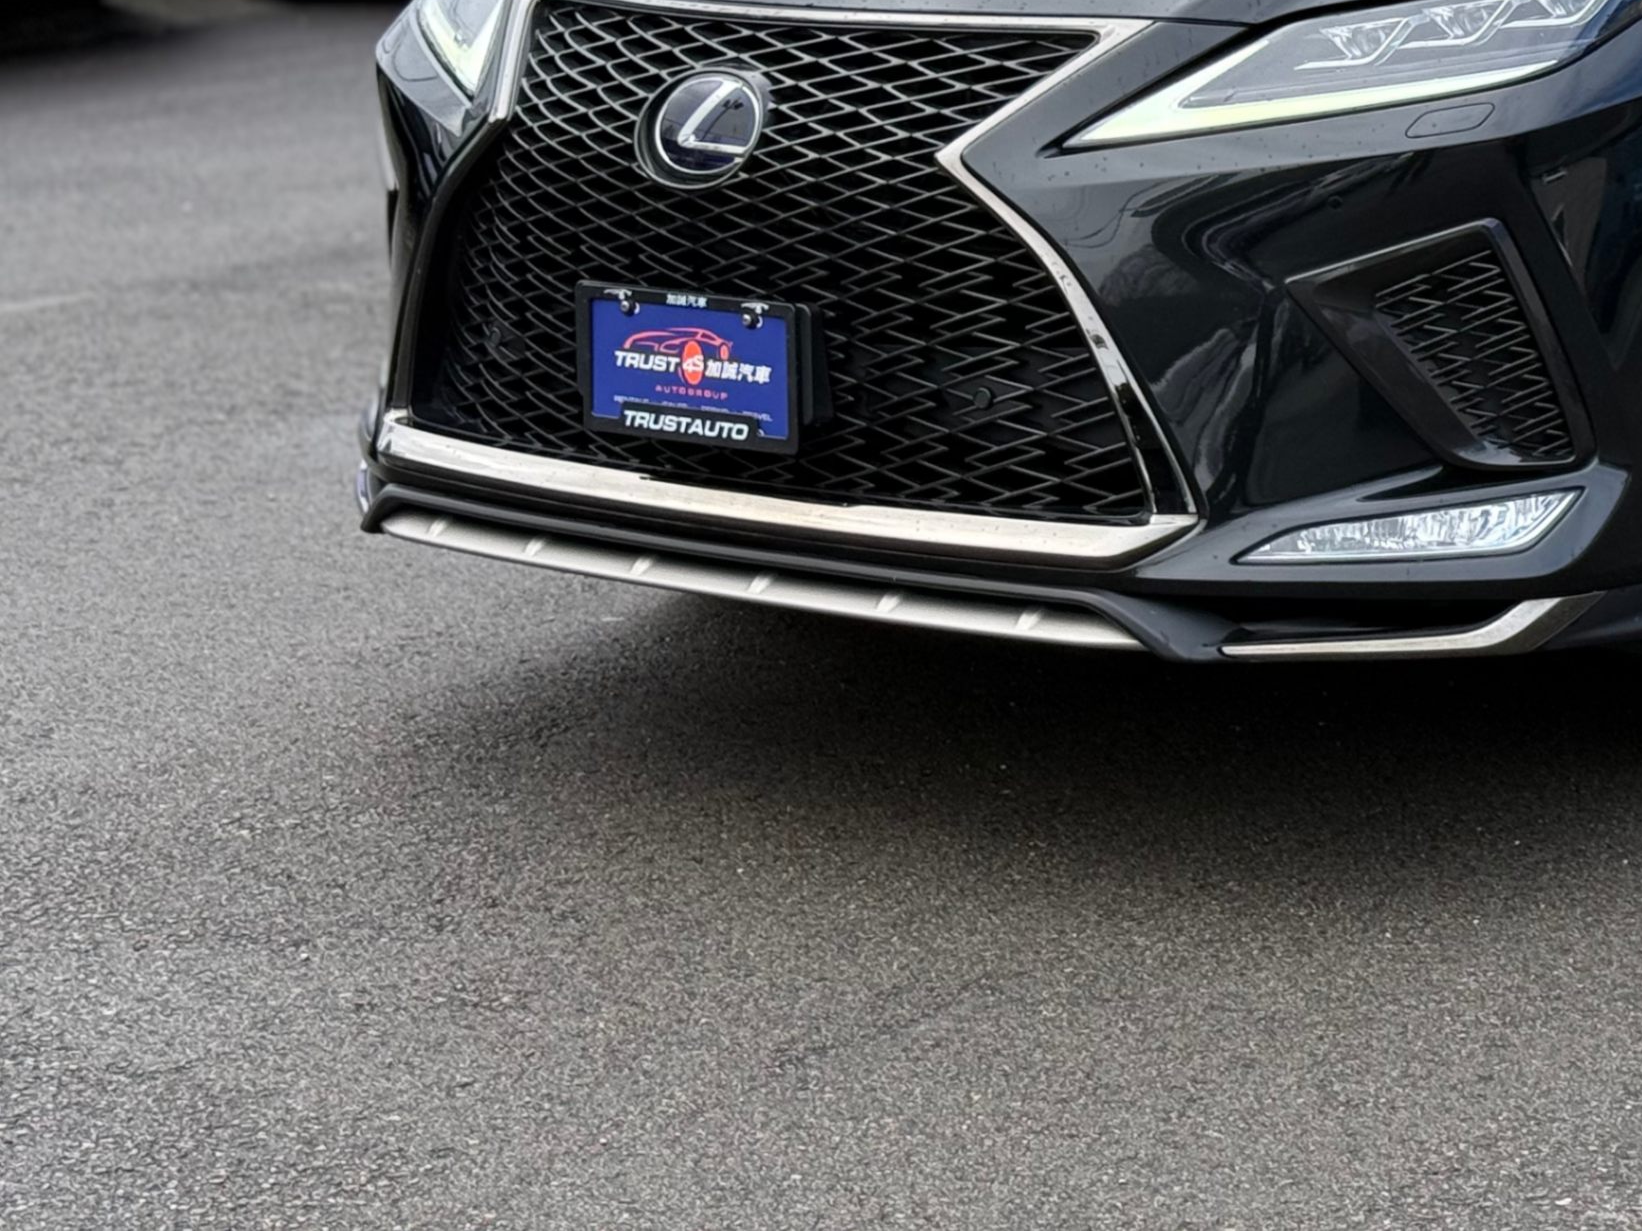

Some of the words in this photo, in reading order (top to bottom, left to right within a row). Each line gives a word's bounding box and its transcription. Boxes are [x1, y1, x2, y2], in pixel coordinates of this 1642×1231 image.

[614, 351, 680, 372] TRUST
[682, 355, 705, 372] 4S
[655, 385, 728, 400] AUTOGROUP
[623, 409, 749, 441] TRUSTAUTO
